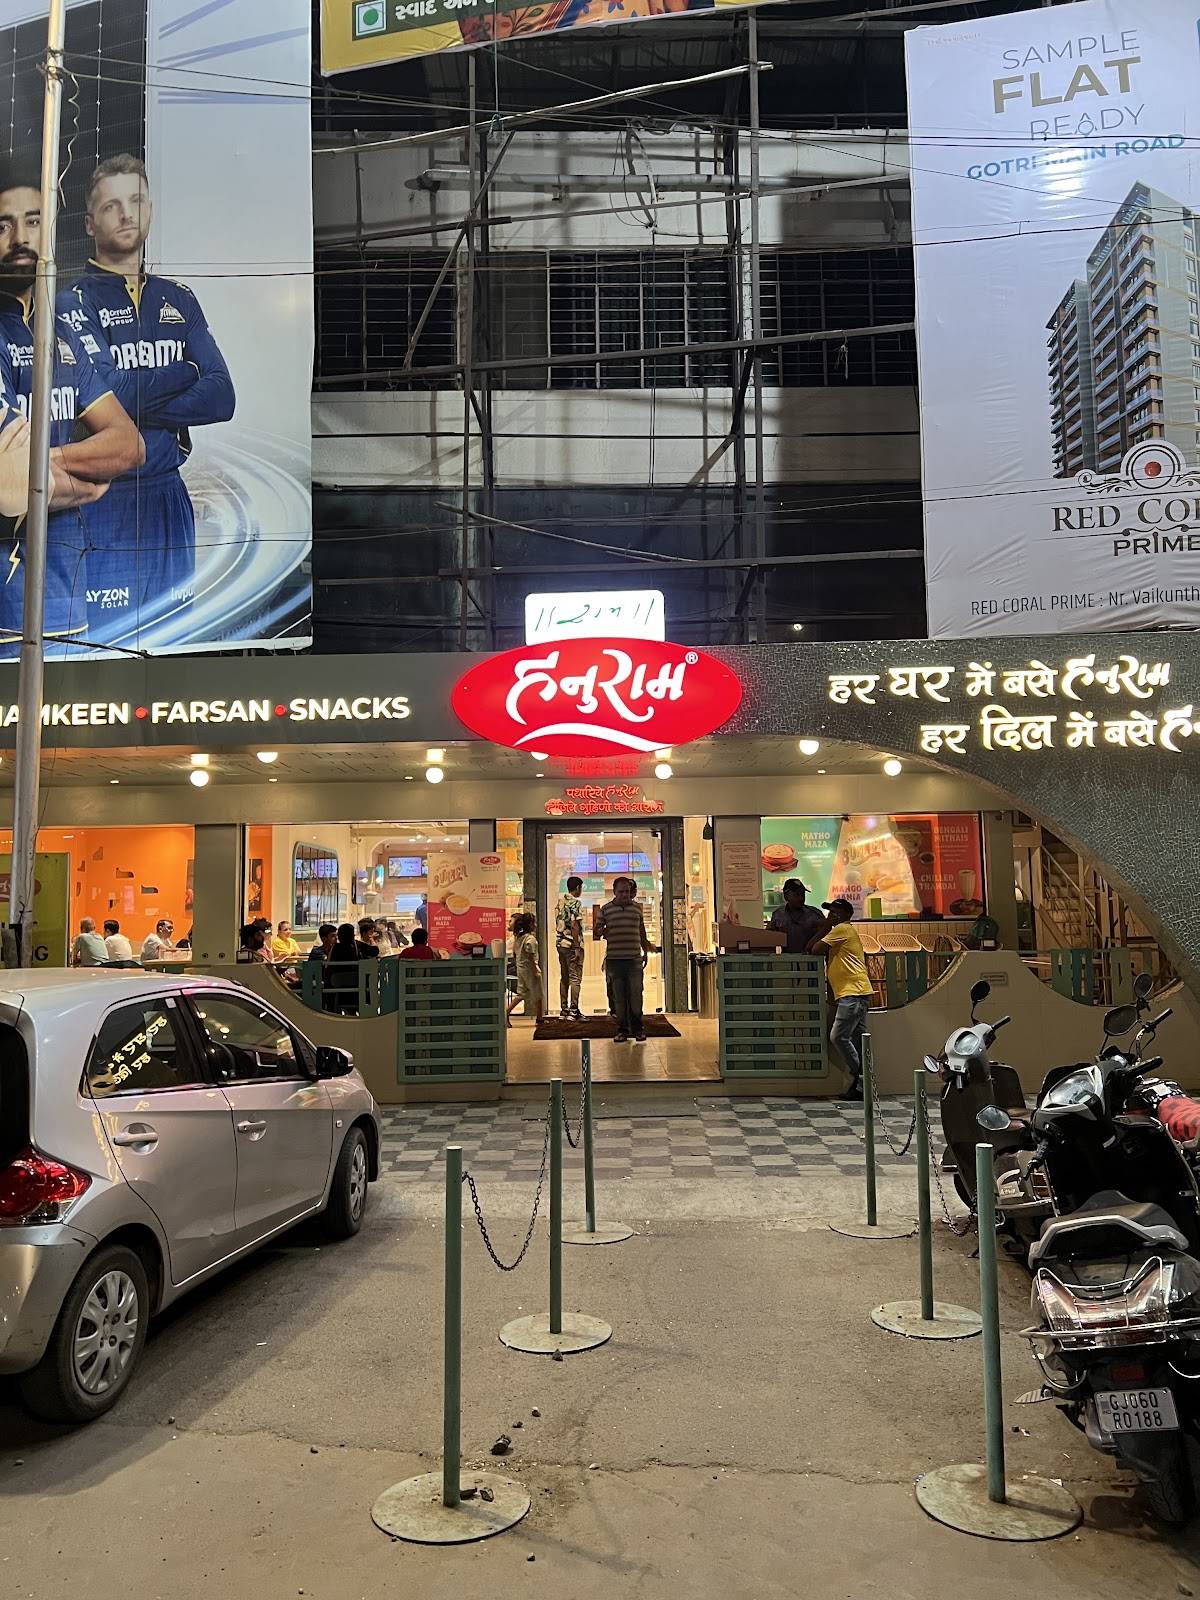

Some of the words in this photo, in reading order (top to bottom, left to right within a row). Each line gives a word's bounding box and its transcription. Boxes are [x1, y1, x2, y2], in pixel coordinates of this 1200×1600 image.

[1002, 29, 1141, 70] SAMPLE
[993, 56, 1141, 113] FLAT
[1115, 134, 1185, 157] ROAD
[1051, 504, 1121, 532] RED
[1137, 498, 1200, 526] CO
[1113, 532, 1200, 557] PRIME
[86, 587, 129, 602] AYZON
[101, 599, 129, 609] SOLAR
[971, 600, 998, 615] RED
[1003, 597, 1047, 613] CORAL
[1051, 593, 1095, 609] PRIME
[1109, 591, 1129, 606] Nr.
[828, 674, 881, 704] हर
[888, 666, 956, 703] घर
[966, 661, 997, 697] में
[1003, 659, 1058, 698] बसे
[151, 699, 270, 725] FARSAN
[289, 696, 410, 722] SNACKS
[920, 724, 970, 754] हर
[979, 704, 1057, 752] दिल
[1066, 711, 1098, 749] में
[1104, 710, 1158, 748] बसे
[832, 884, 862, 893] MANGO
[920, 873, 954, 882] CHILLED
[1112, 1410, 1163, 1430] R0188
